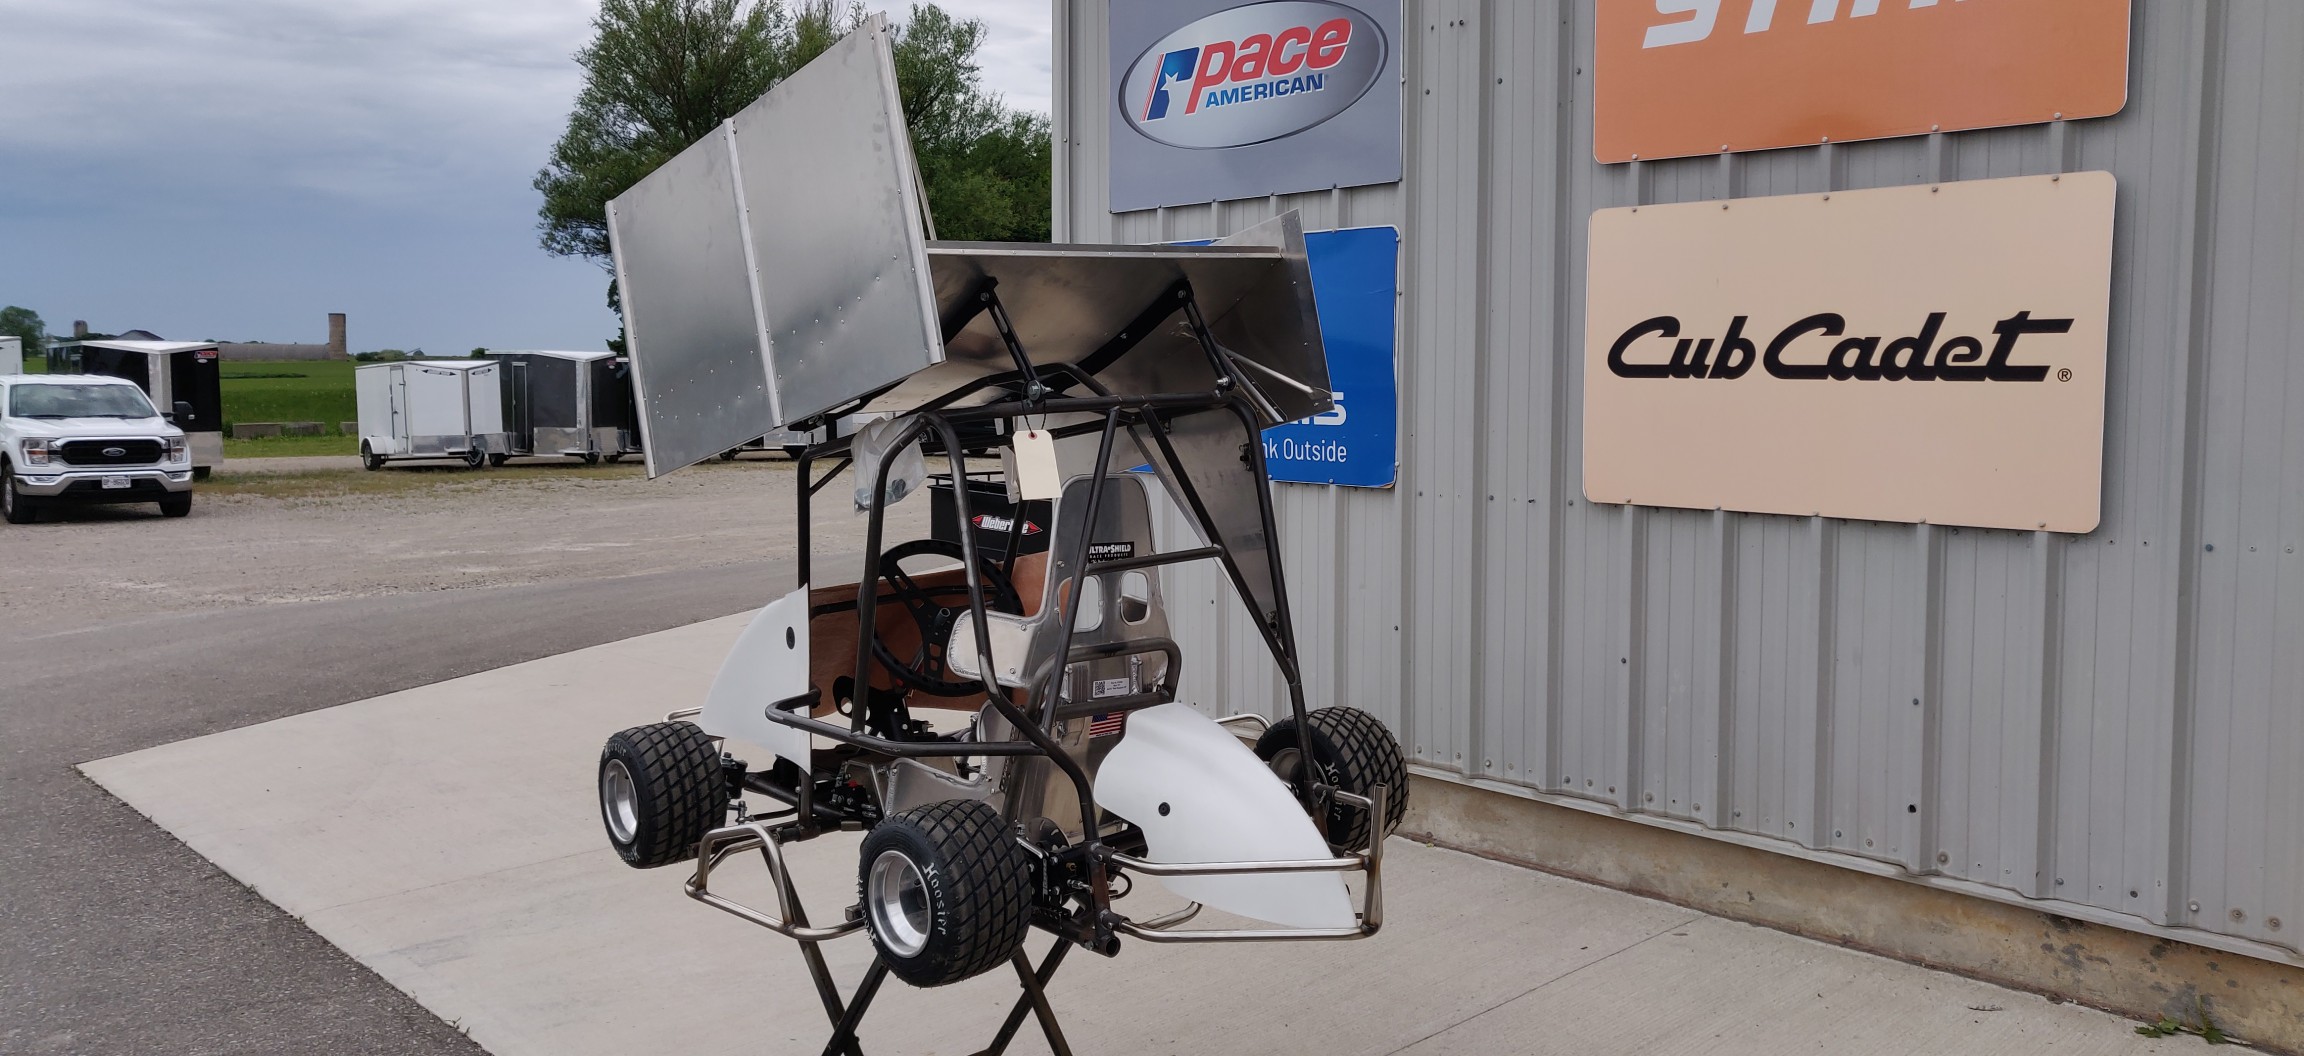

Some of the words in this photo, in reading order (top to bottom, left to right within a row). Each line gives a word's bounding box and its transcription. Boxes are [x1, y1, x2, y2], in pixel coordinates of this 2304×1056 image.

[1184, 18, 1353, 116] pace
[1205, 73, 1324, 109] AMERICAN
[1607, 316, 1757, 380] Cub
[1283, 437, 1347, 463] Outside
[981, 516, 1029, 534] Webere
[1324, 761, 1343, 821] Hoier
[921, 862, 948, 936] Hoosier
